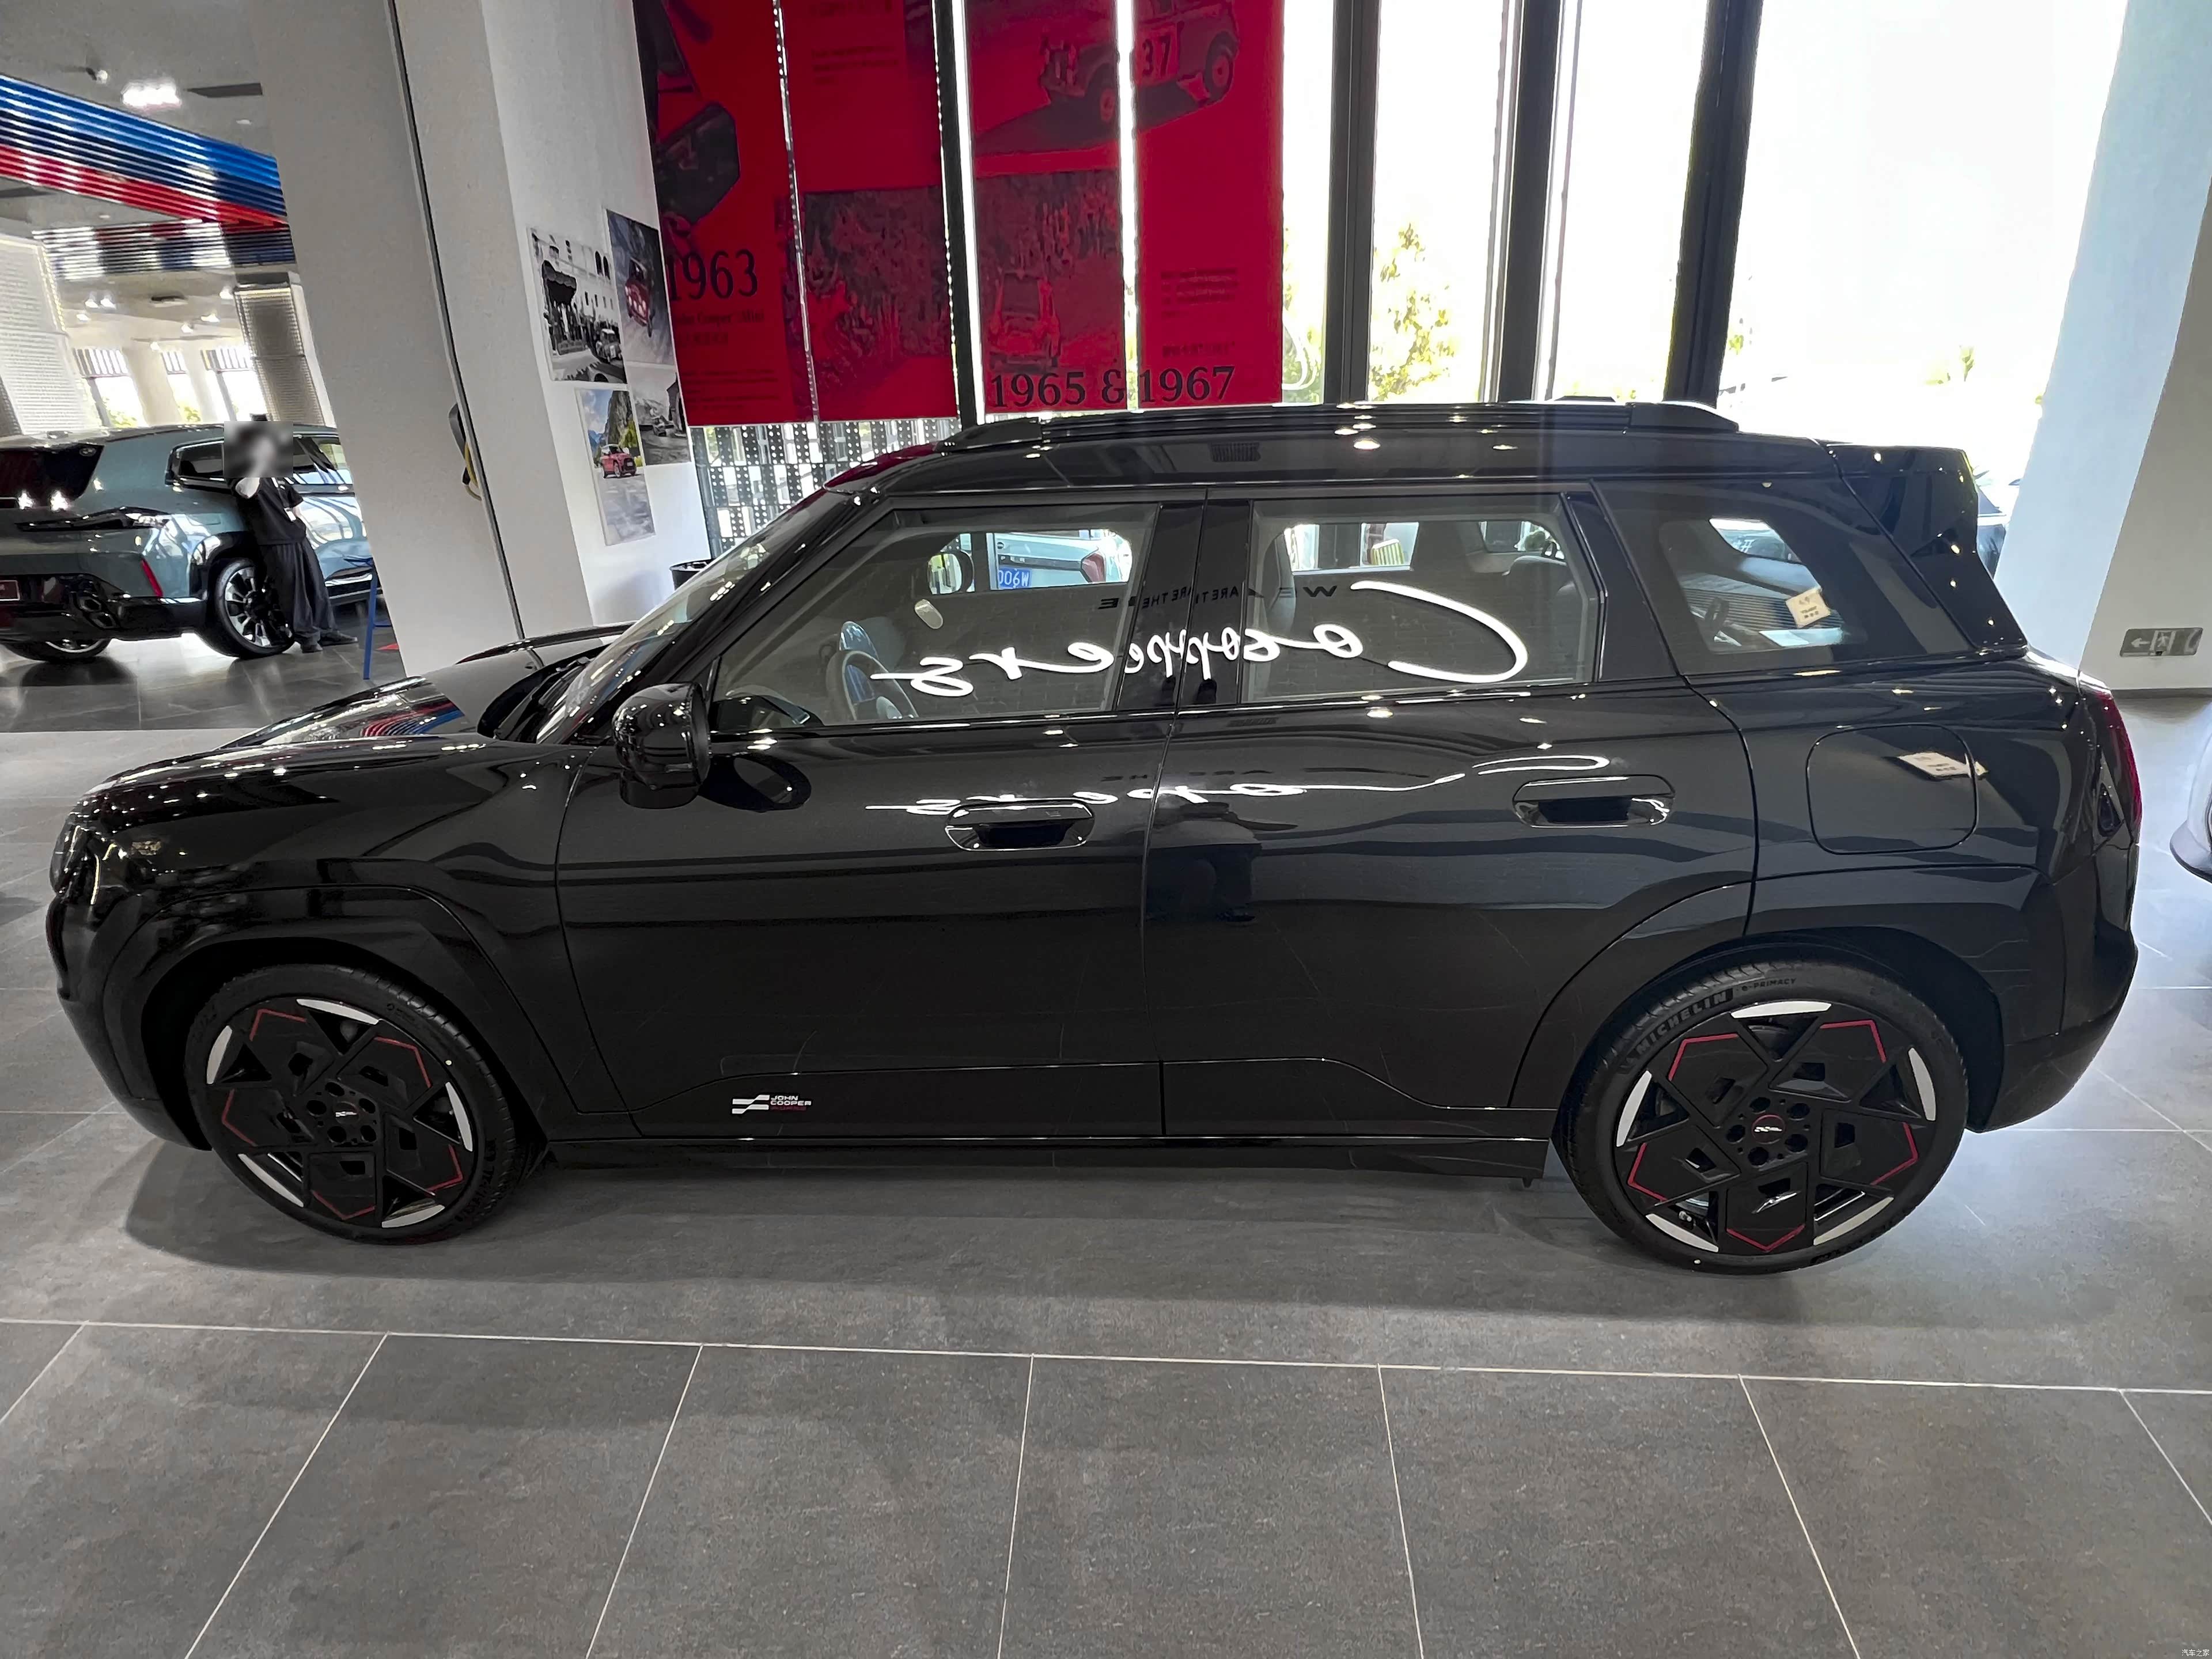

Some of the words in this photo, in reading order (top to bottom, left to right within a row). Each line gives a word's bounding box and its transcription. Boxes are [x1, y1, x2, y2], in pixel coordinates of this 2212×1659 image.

[665, 248, 758, 301] 1963
[991, 372, 1086, 407] 1965
[1101, 368, 1125, 403] &
[1138, 365, 1236, 403] 1967
[1635, 988, 1729, 1056] MICHELIN
